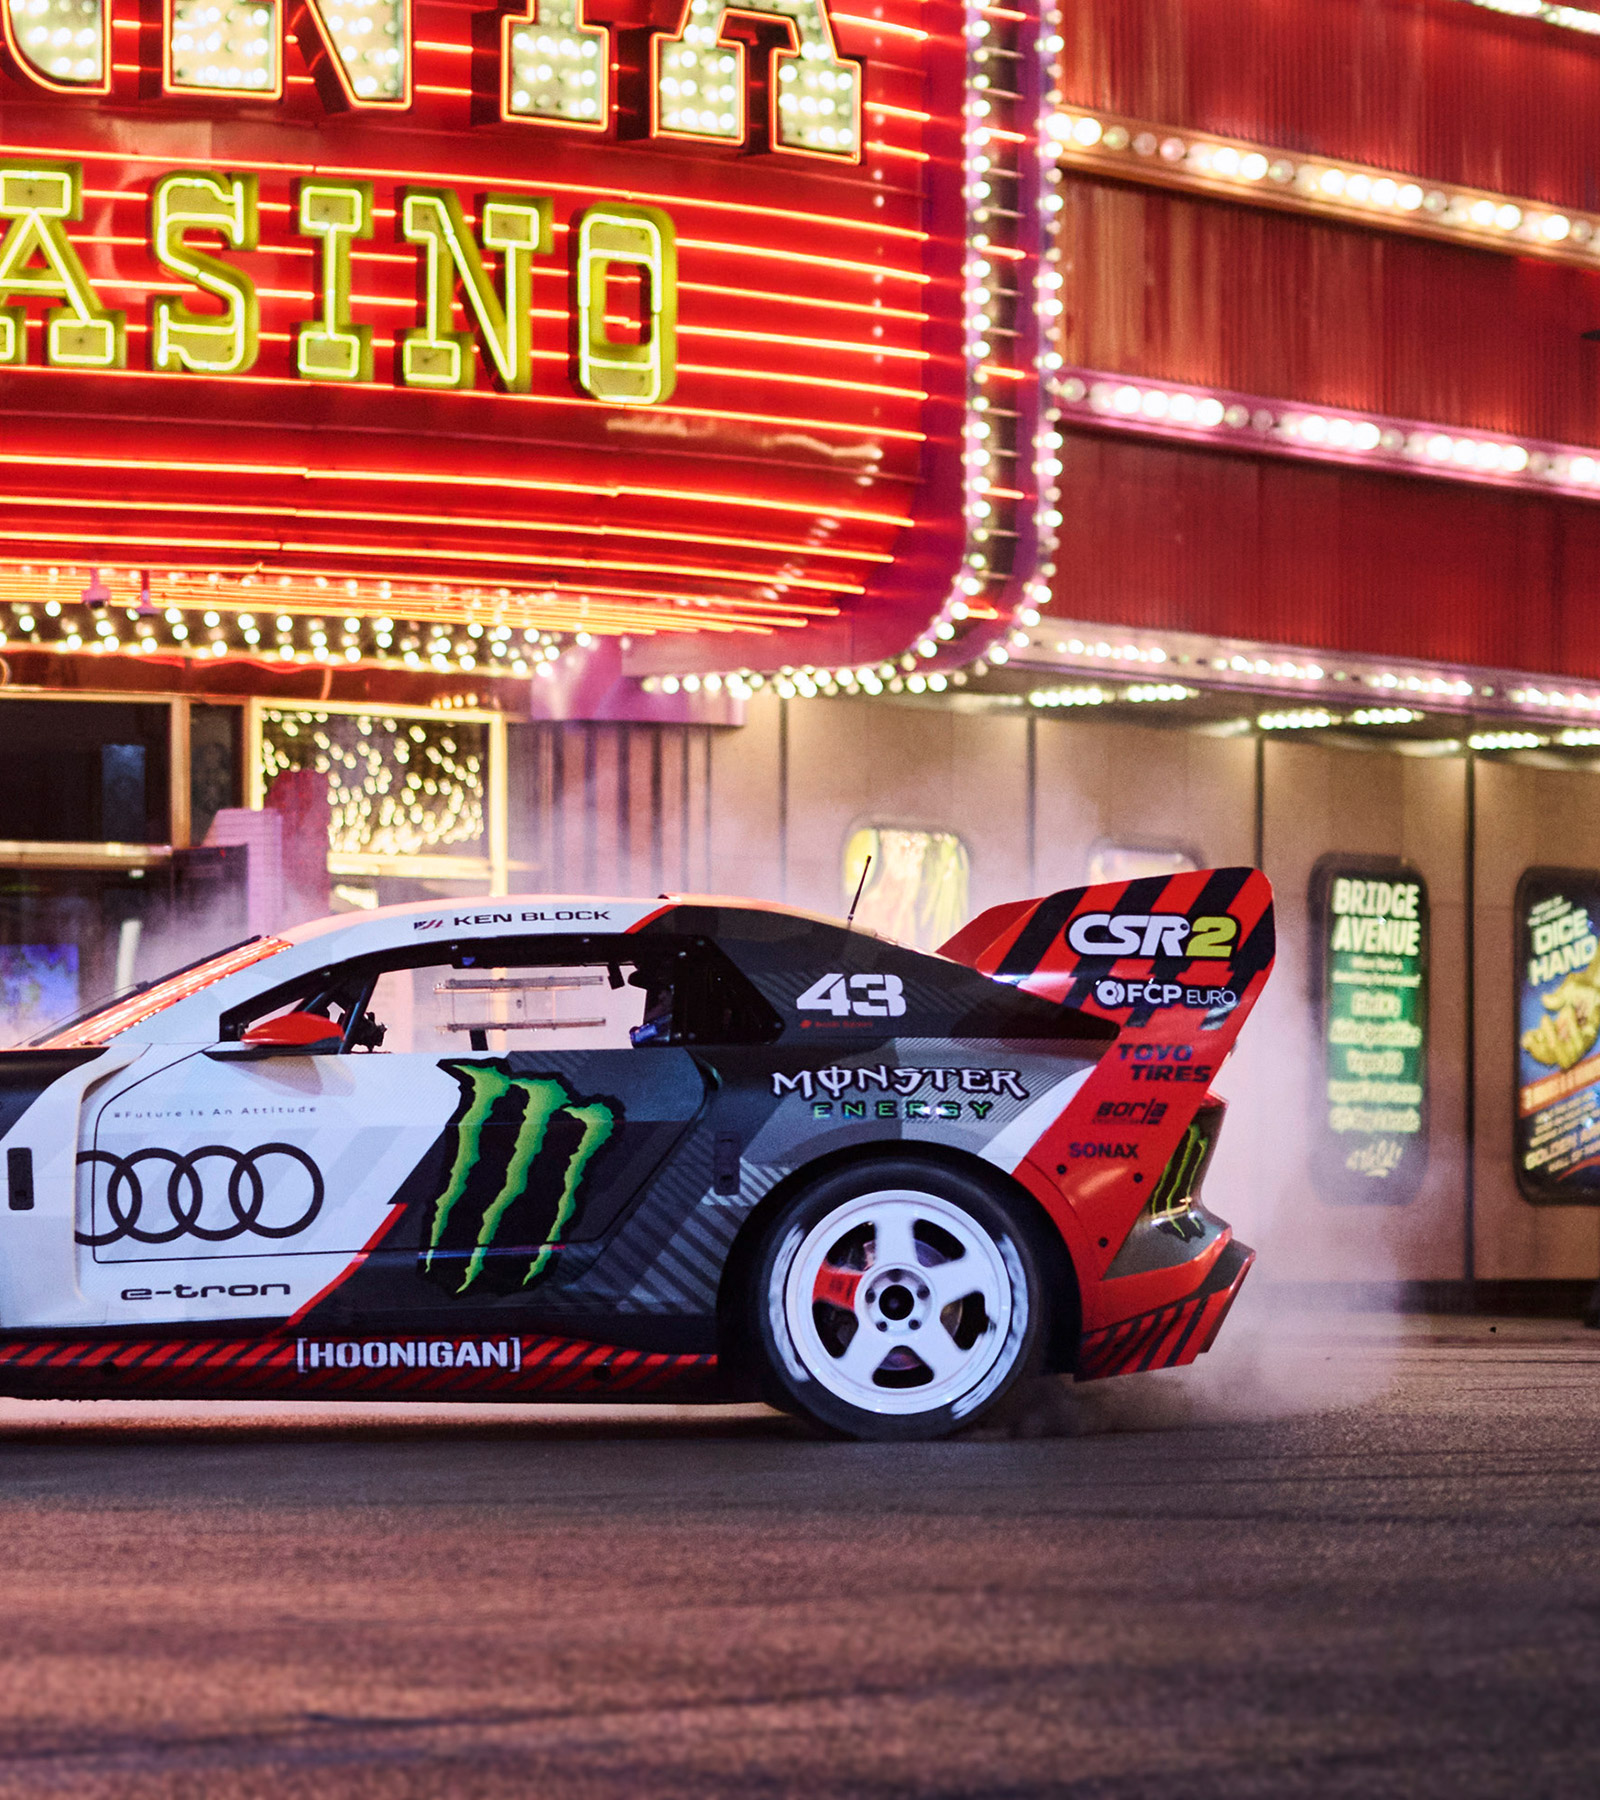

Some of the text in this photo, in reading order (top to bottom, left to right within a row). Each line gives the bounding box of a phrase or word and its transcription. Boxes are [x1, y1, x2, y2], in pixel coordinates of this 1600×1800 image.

[1332, 877, 1420, 919] BRIDGE
[454, 910, 611, 926] KEN BLOCK
[1068, 913, 1237, 957] CSR2
[1332, 915, 1421, 956] AVENUE
[1534, 908, 1589, 955] DICE
[1529, 934, 1597, 986] HAND
[796, 973, 907, 1016] 43
[1127, 983, 1237, 1005] FCP EURO
[1117, 1044, 1194, 1061] TOYO
[771, 1065, 1028, 1099] MONSTER
[1131, 1064, 1212, 1083] TIRES
[212, 1108, 233, 1116] An
[241, 1105, 317, 1115] Attitude
[813, 1102, 992, 1119] ENERGY
[1069, 1142, 1139, 1159] SONAX
[120, 1282, 291, 1300] e-tron
